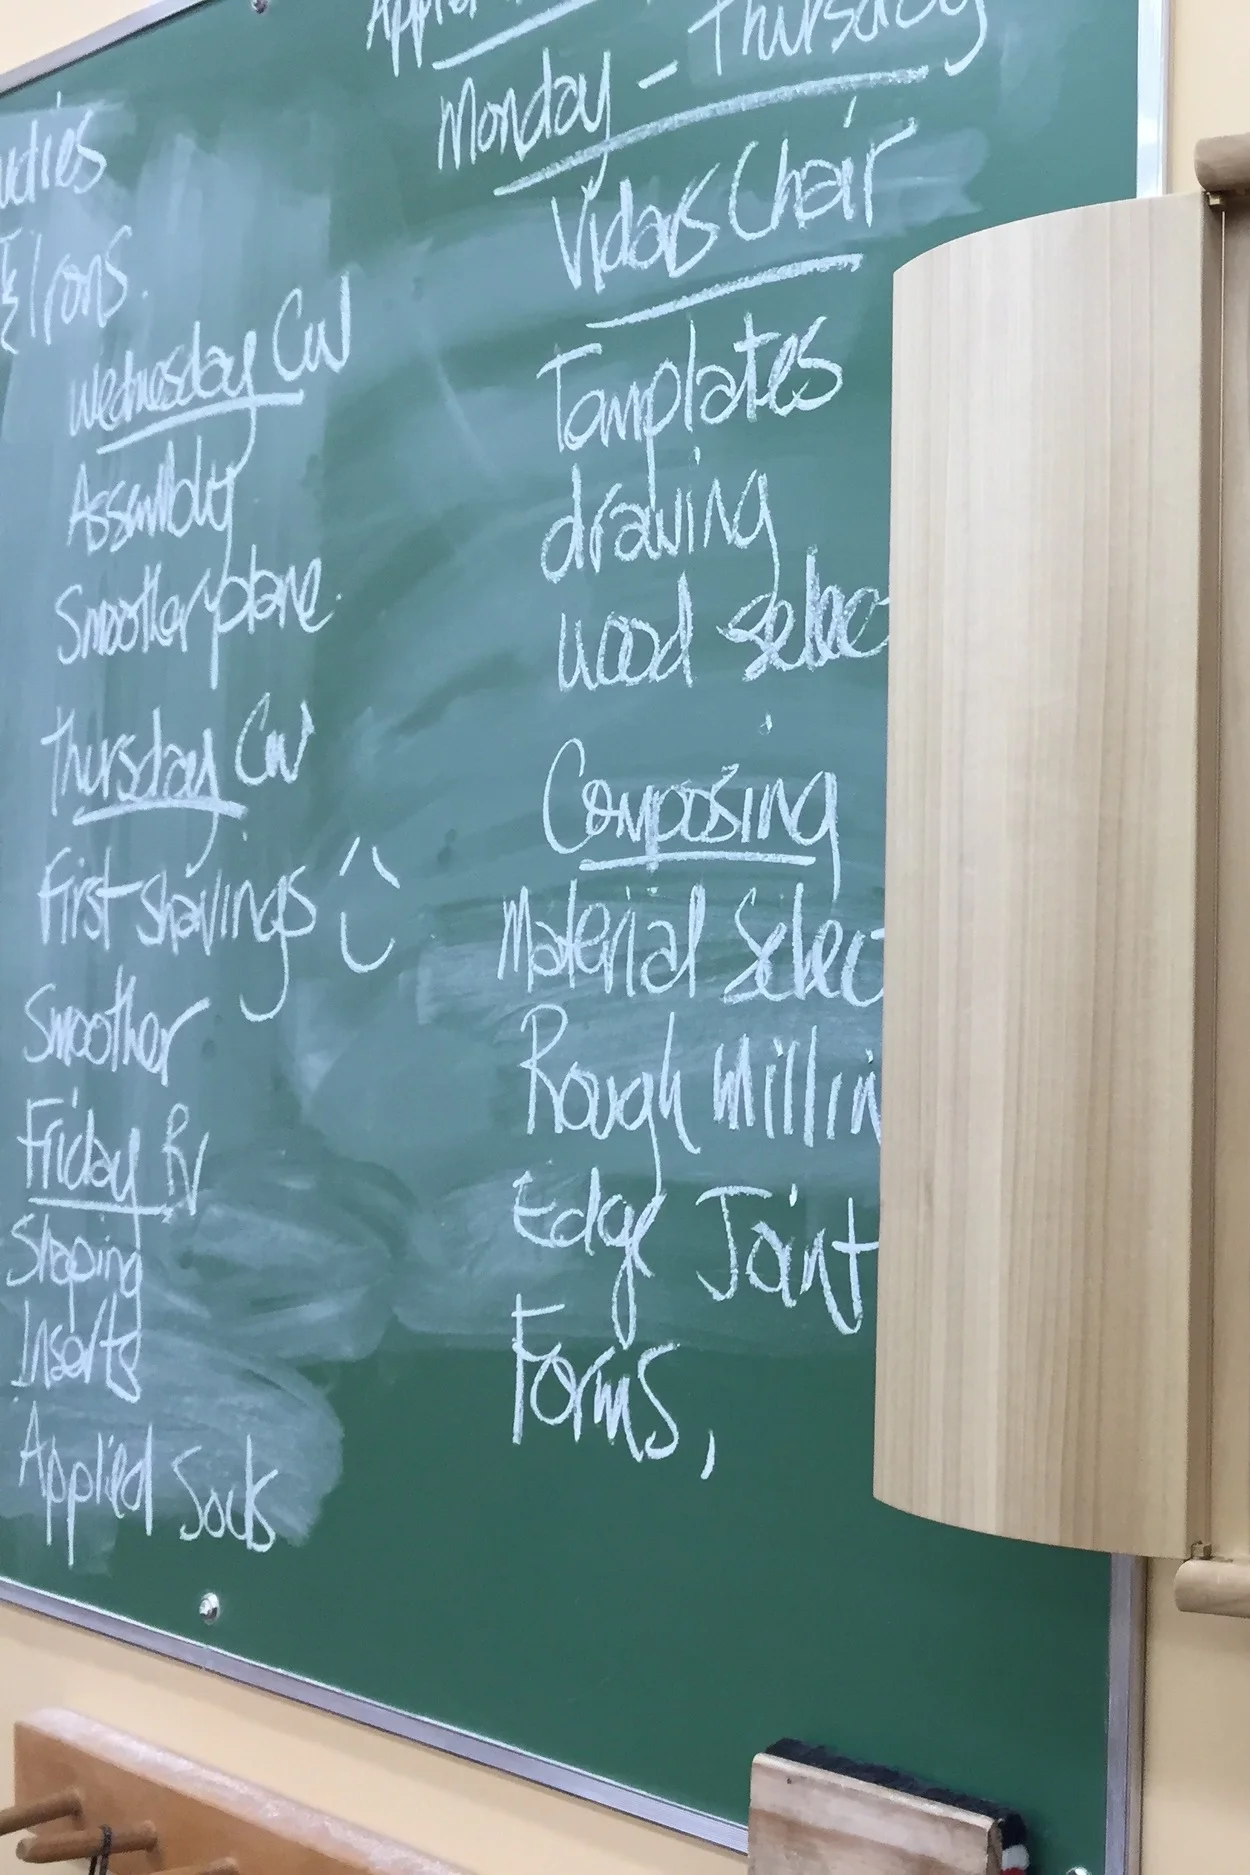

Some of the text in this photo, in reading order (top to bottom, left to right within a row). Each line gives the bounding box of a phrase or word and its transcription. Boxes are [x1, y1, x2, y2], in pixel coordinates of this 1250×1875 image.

[438, 47, 612, 202] Monday
[728, 95, 919, 241] Chair
[540, 446, 780, 603] drawing
[40, 705, 220, 878] Thursday
[542, 713, 842, 901] Composing
[498, 878, 706, 998] Material
[23, 964, 210, 1088] Smoother
[519, 1003, 701, 1196] Rough
[18, 1400, 152, 1569] Applied
